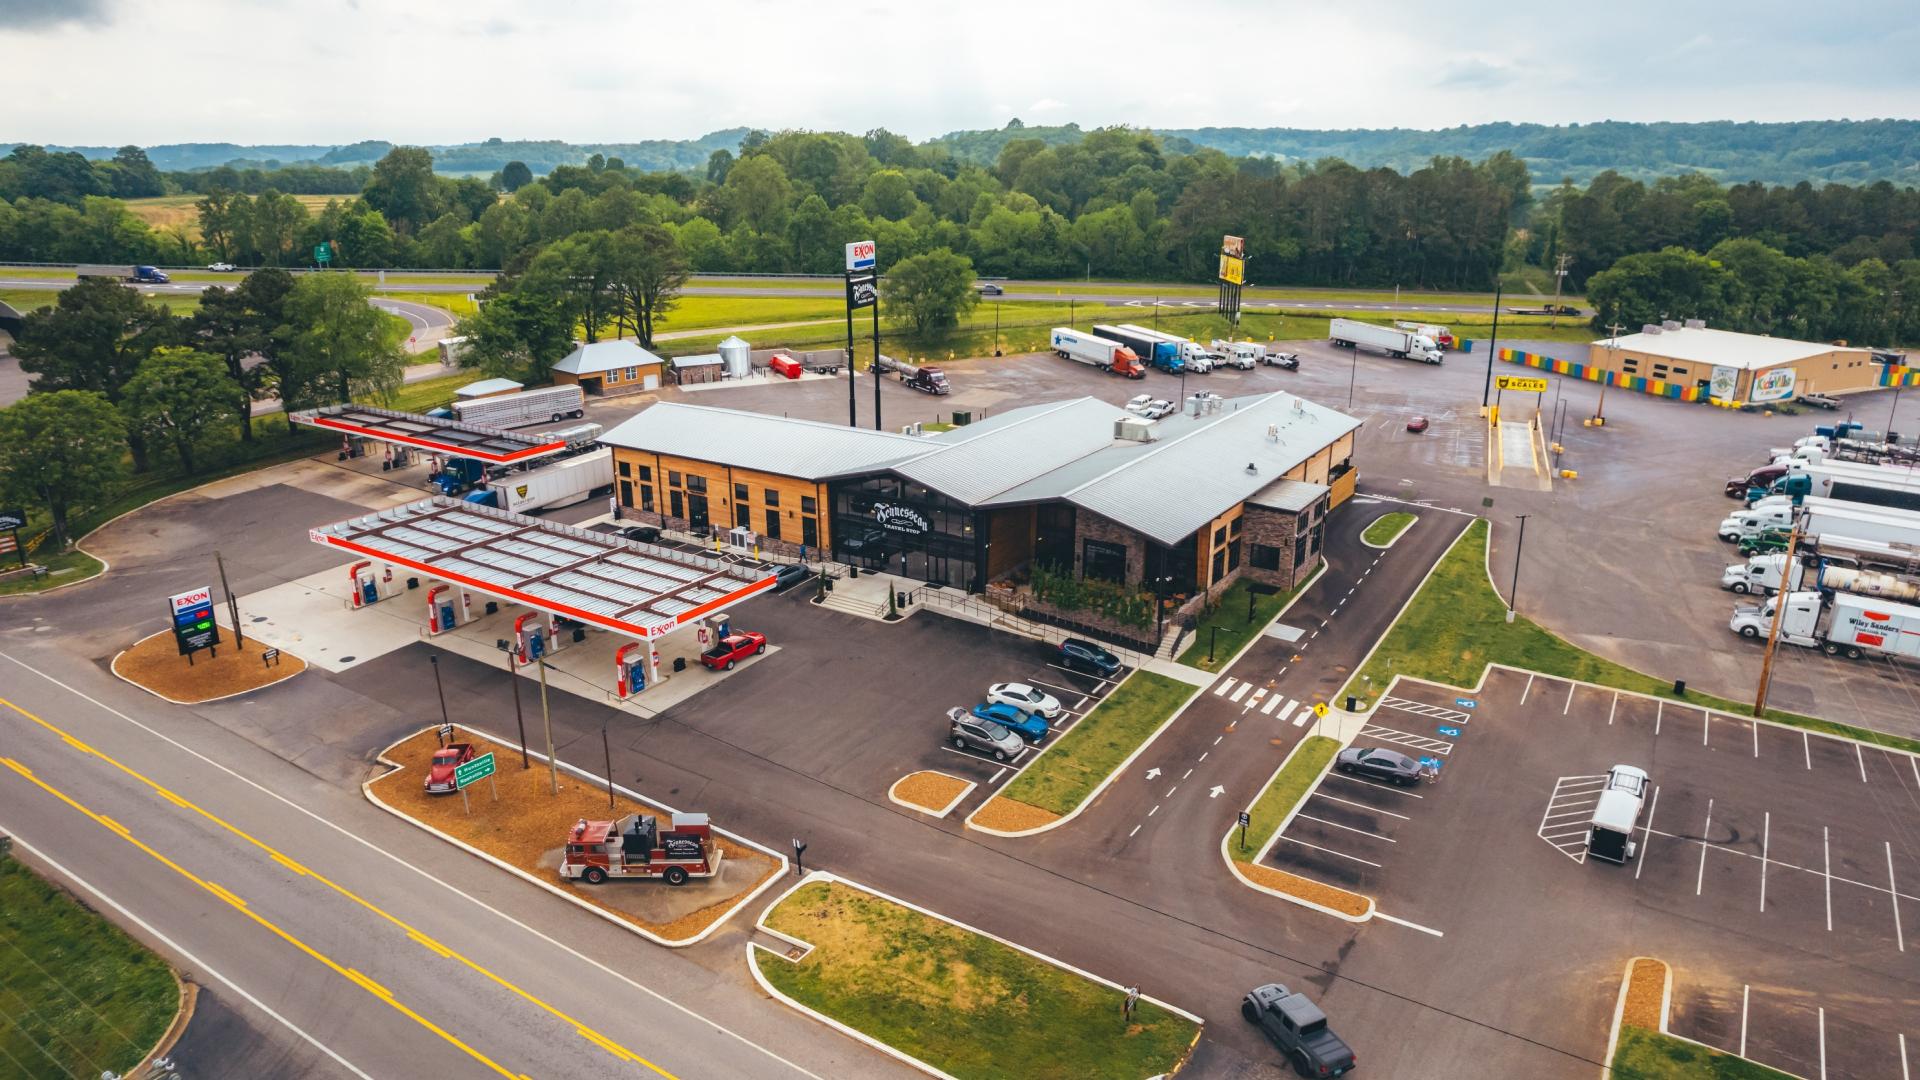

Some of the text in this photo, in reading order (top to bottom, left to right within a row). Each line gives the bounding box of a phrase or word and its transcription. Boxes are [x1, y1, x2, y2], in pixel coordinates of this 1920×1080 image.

[854, 244, 874, 258] EXXON
[874, 502, 928, 532] Tennessean
[884, 523, 906, 532] TRAVEL
[176, 592, 208, 606] EXXON
[651, 620, 675, 636] Exxon
[1849, 617, 1900, 633] Wiley Sanders
